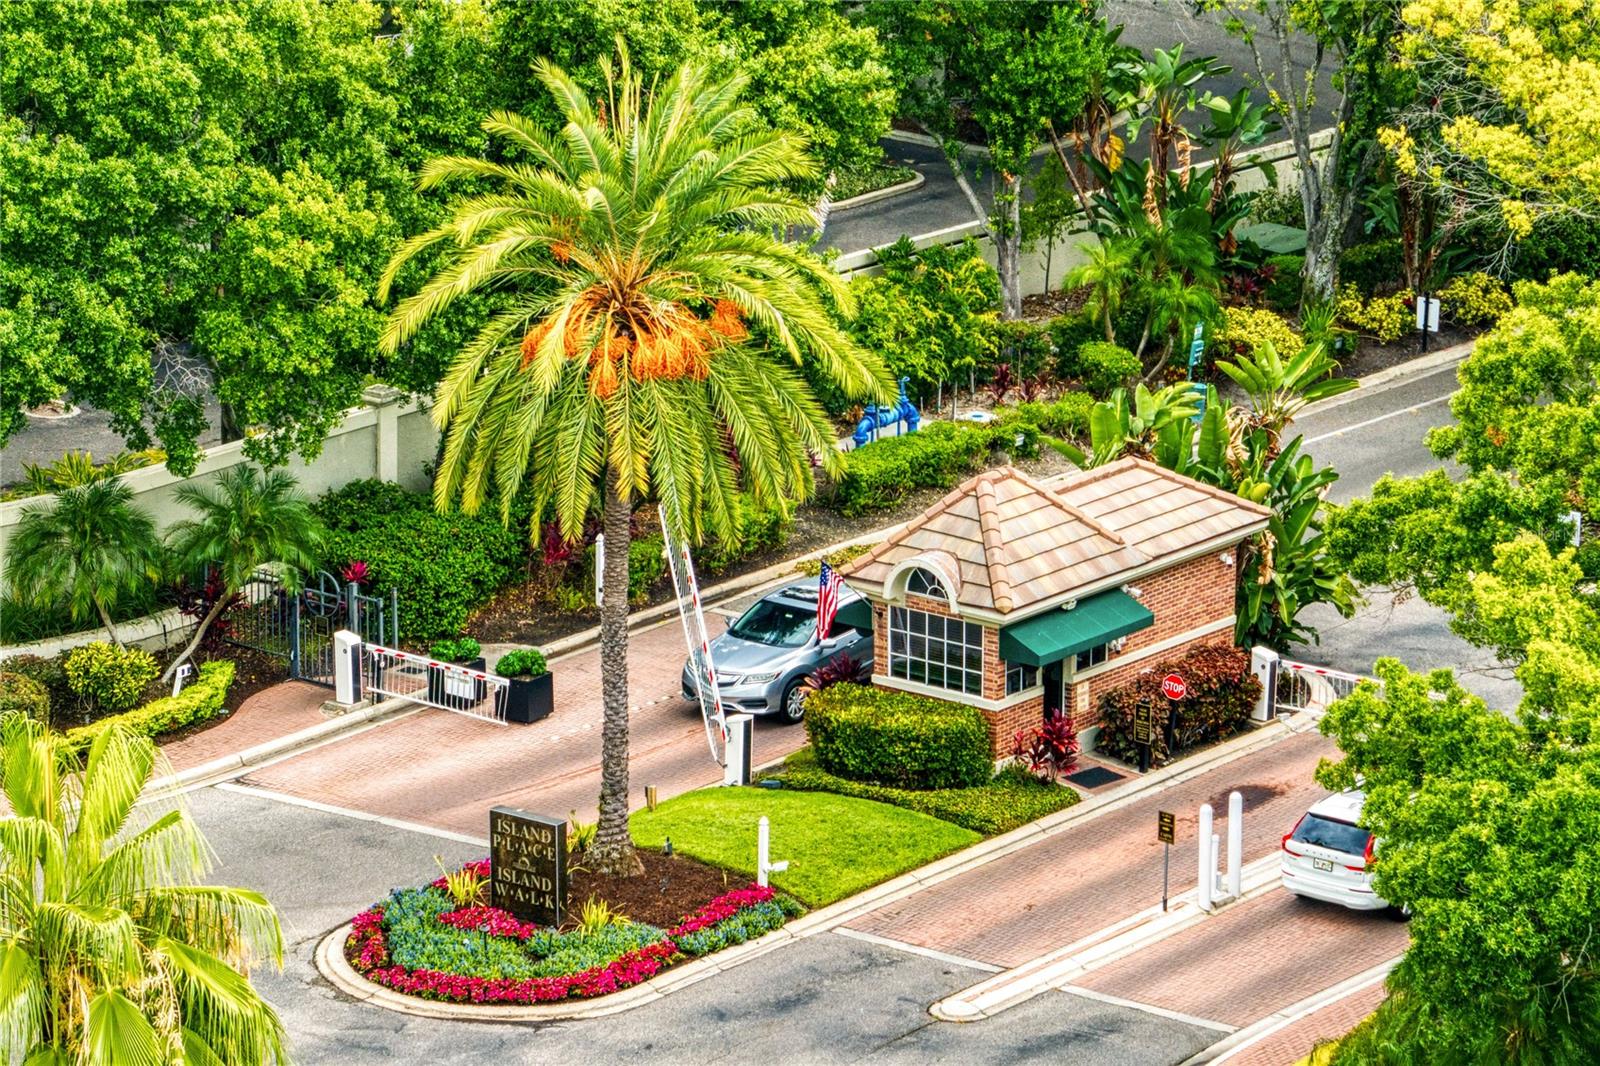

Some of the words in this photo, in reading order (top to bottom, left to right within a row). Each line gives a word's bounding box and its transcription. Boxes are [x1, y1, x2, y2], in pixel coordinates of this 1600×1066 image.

[1164, 681, 1184, 693] STOP
[497, 819, 552, 844] ISLAND
[498, 866, 552, 892] ISLAND
